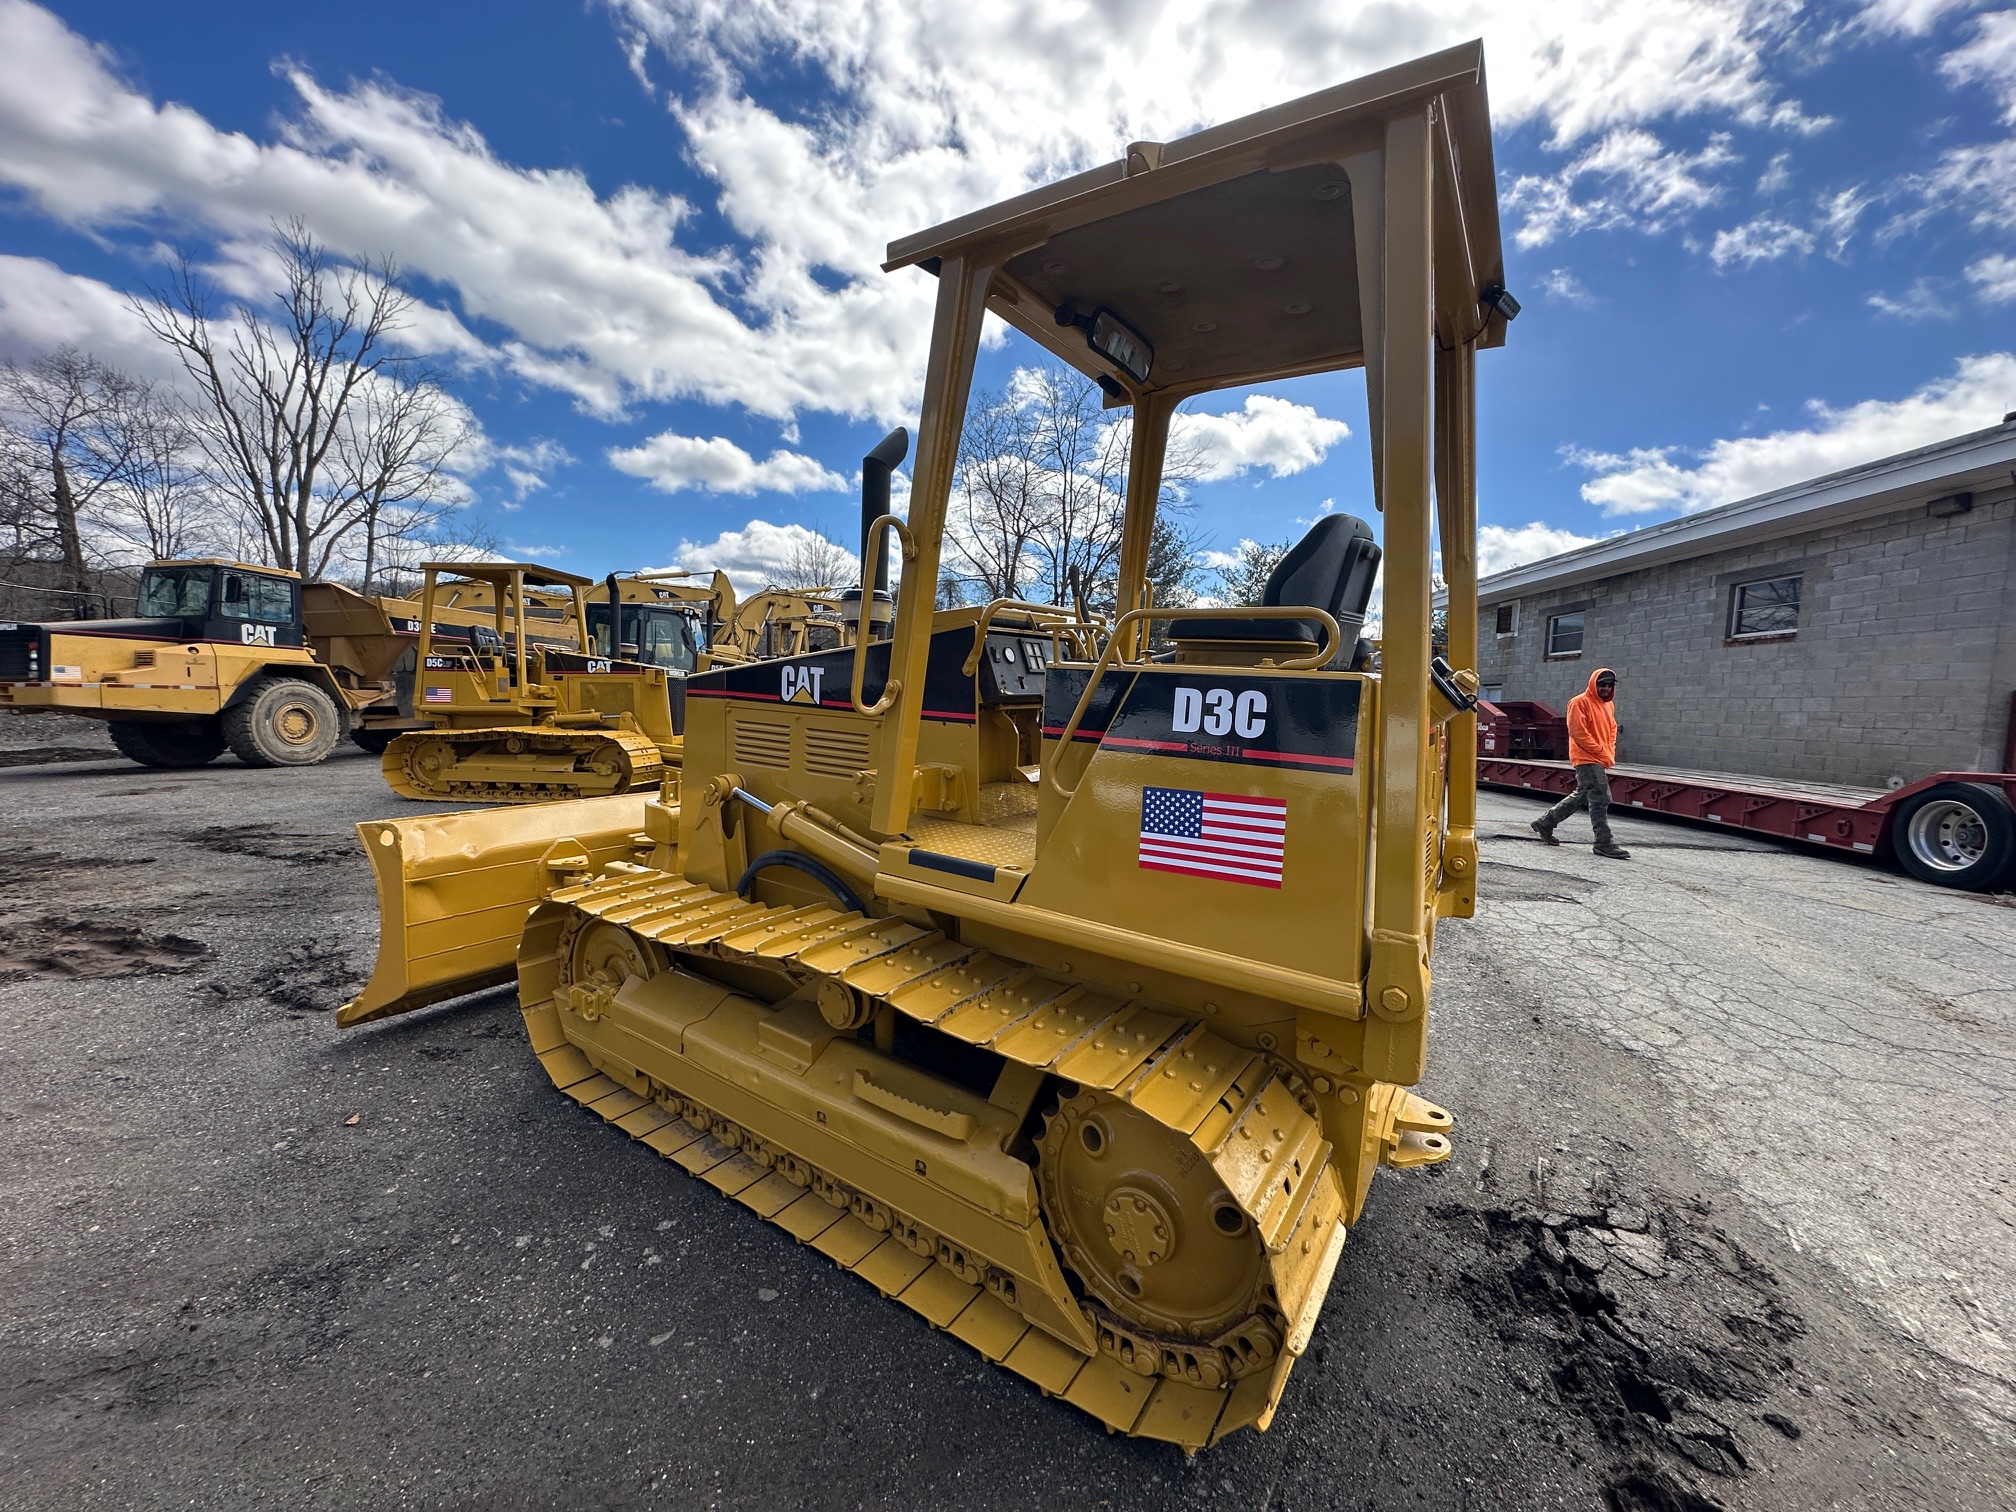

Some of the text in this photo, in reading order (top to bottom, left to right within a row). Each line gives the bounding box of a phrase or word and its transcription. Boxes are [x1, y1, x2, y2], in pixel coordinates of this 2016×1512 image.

[658, 591, 670, 599] CAT
[813, 604, 824, 613] CAT
[241, 623, 277, 647] CAT
[426, 657, 443, 668] D5C
[587, 660, 613, 674] CAT
[781, 665, 825, 705] CAT
[1172, 687, 1268, 739] D3C
[1190, 742, 1240, 757] Series III
